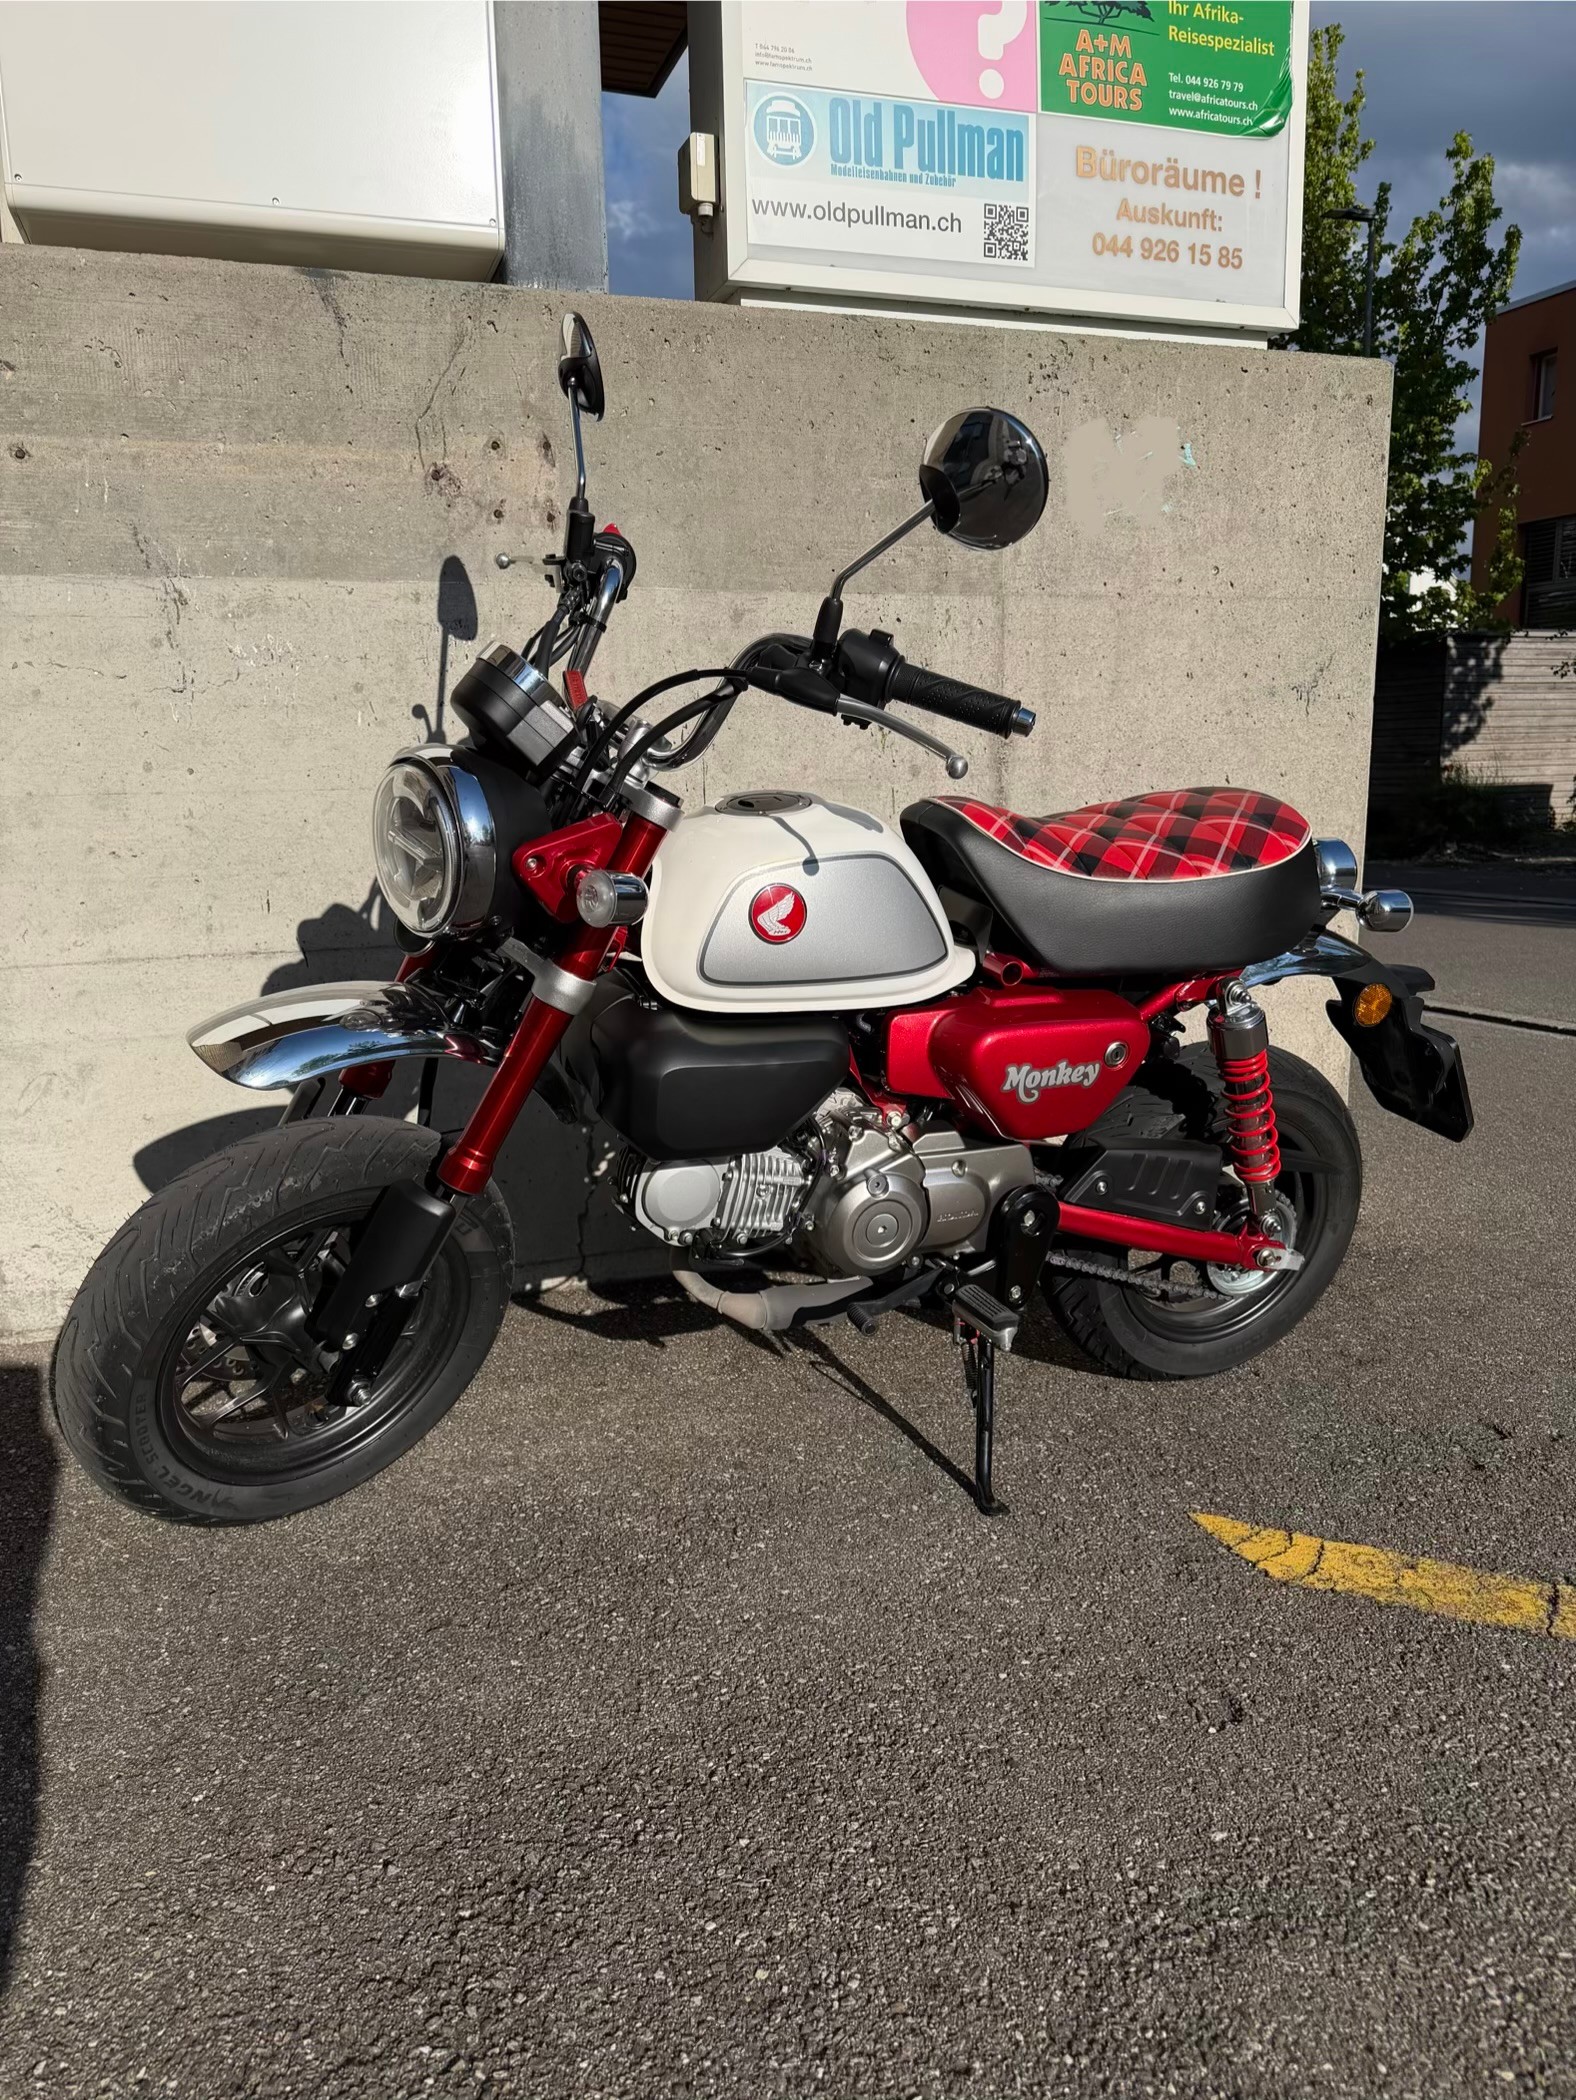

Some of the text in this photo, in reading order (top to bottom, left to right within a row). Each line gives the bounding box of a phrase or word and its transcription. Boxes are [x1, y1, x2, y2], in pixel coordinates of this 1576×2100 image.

[1168, 0, 1244, 25] Ihr Afrika-
[1076, 28, 1132, 59] A+M
[1168, 25, 1275, 56] Reisespezialist
[1058, 52, 1148, 87] AFRICA
[1168, 72, 1244, 93] Tel. 044 926 79 79
[1066, 79, 1143, 112] TOURS
[1168, 89, 1258, 112] travel@africatours.ch
[1168, 105, 1253, 126] www.africatours.ch
[829, 97, 1024, 182] Old Pullman
[830, 163, 956, 188] Modelleisenbahnen und Zubehör
[1075, 145, 1245, 197] Büroräume
[752, 198, 962, 233] www.oldpullman.ch
[1116, 197, 1223, 232] Auskunft:
[1092, 232, 1243, 270] 044 926 15 85
[1001, 1058, 1101, 1105] Monkey
